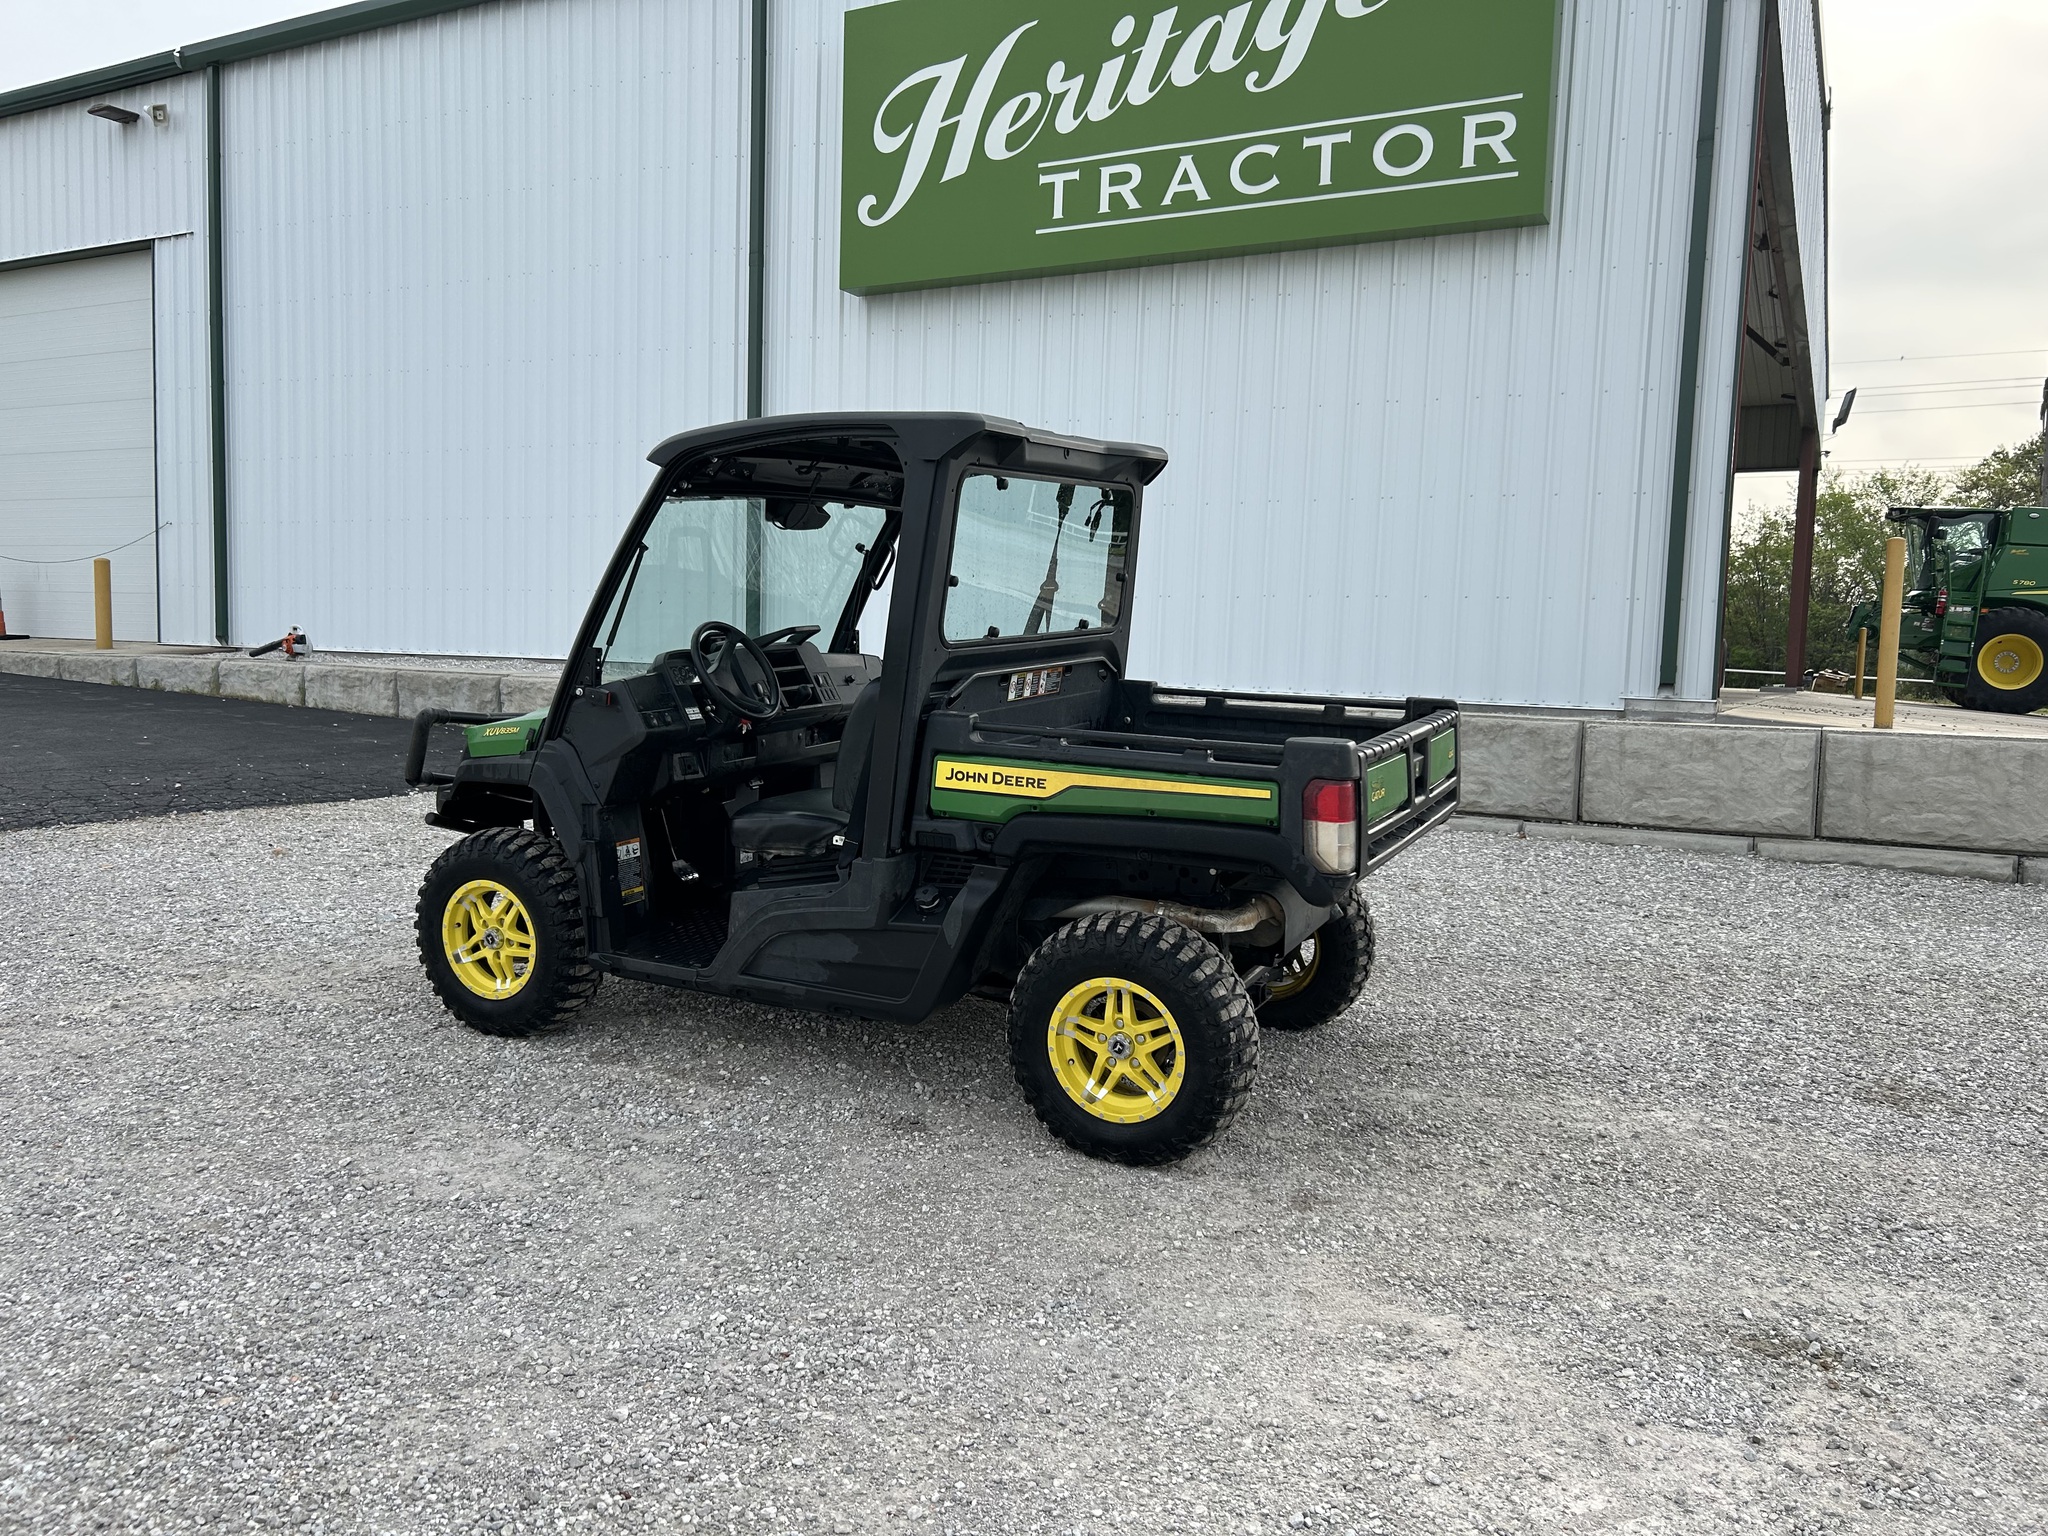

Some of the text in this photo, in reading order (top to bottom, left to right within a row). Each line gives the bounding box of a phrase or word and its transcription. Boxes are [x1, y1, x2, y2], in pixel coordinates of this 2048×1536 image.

[1038, 110, 1518, 220] TRACTOR
[945, 767, 1047, 790] JOHN DEERE
